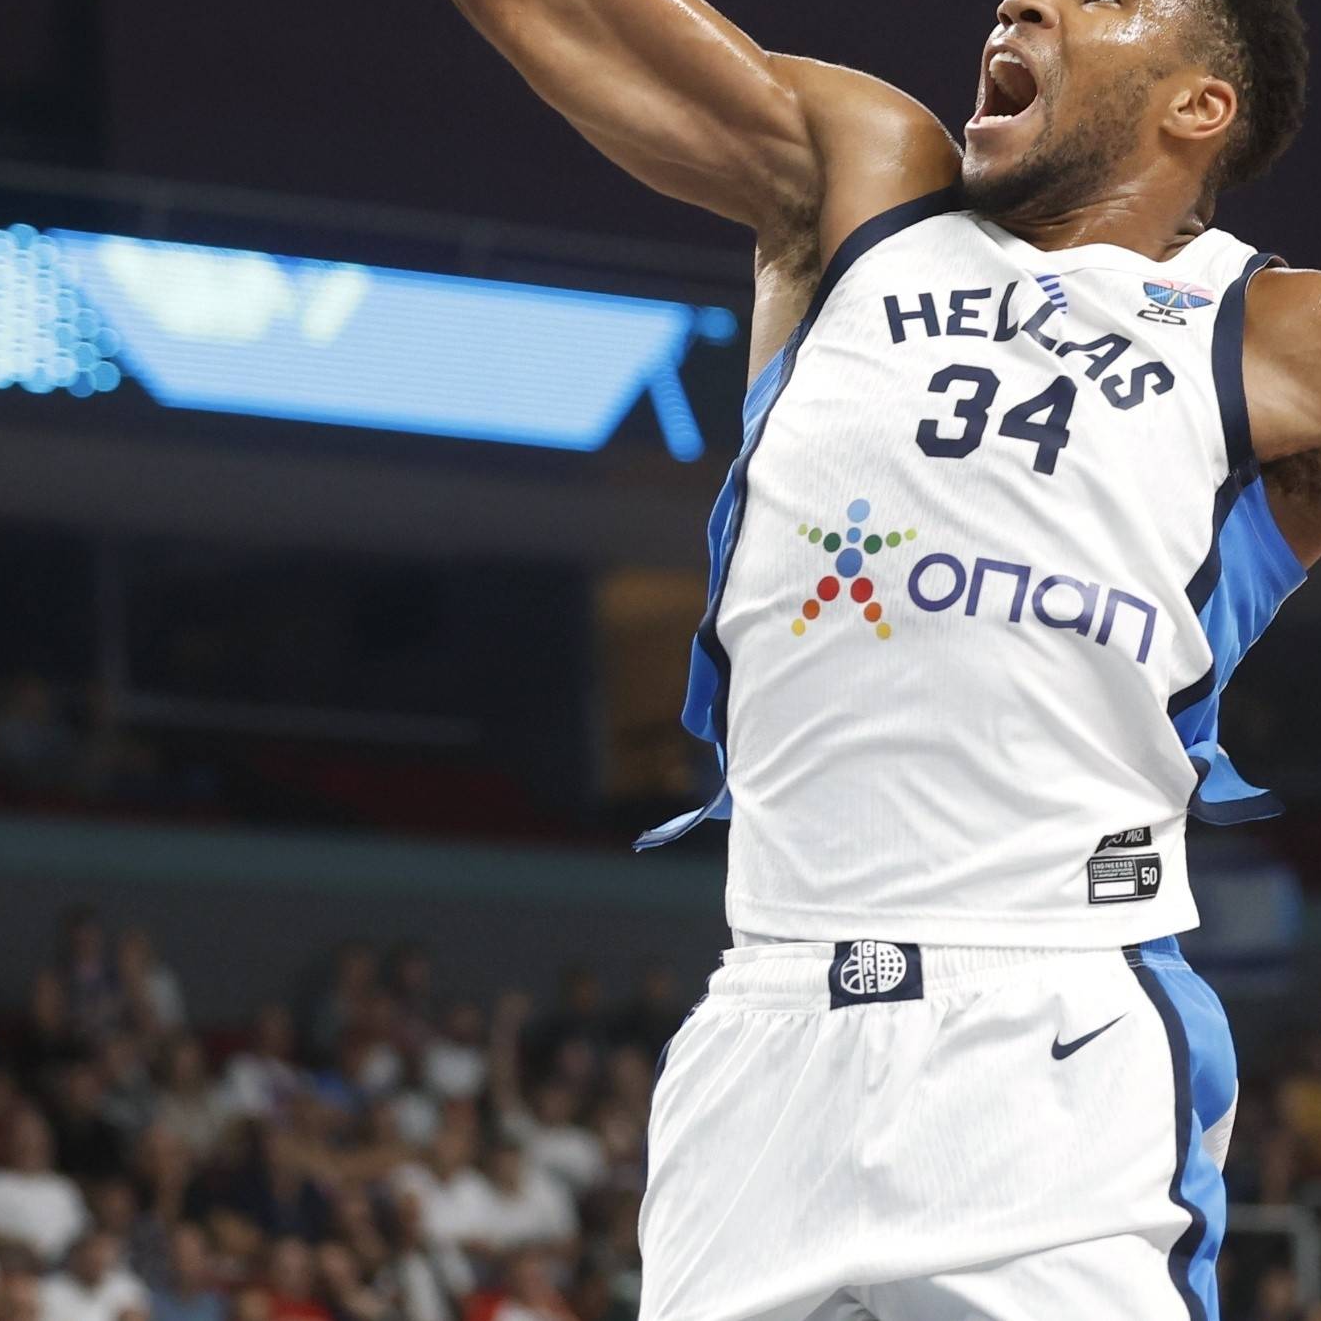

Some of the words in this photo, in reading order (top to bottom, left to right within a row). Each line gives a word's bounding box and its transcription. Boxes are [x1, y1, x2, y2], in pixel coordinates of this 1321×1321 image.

[883, 280, 1176, 411] HELLAS
[915, 363, 1078, 476] 34
[1140, 866, 1158, 886] 50
[862, 941, 876, 993] GRE
